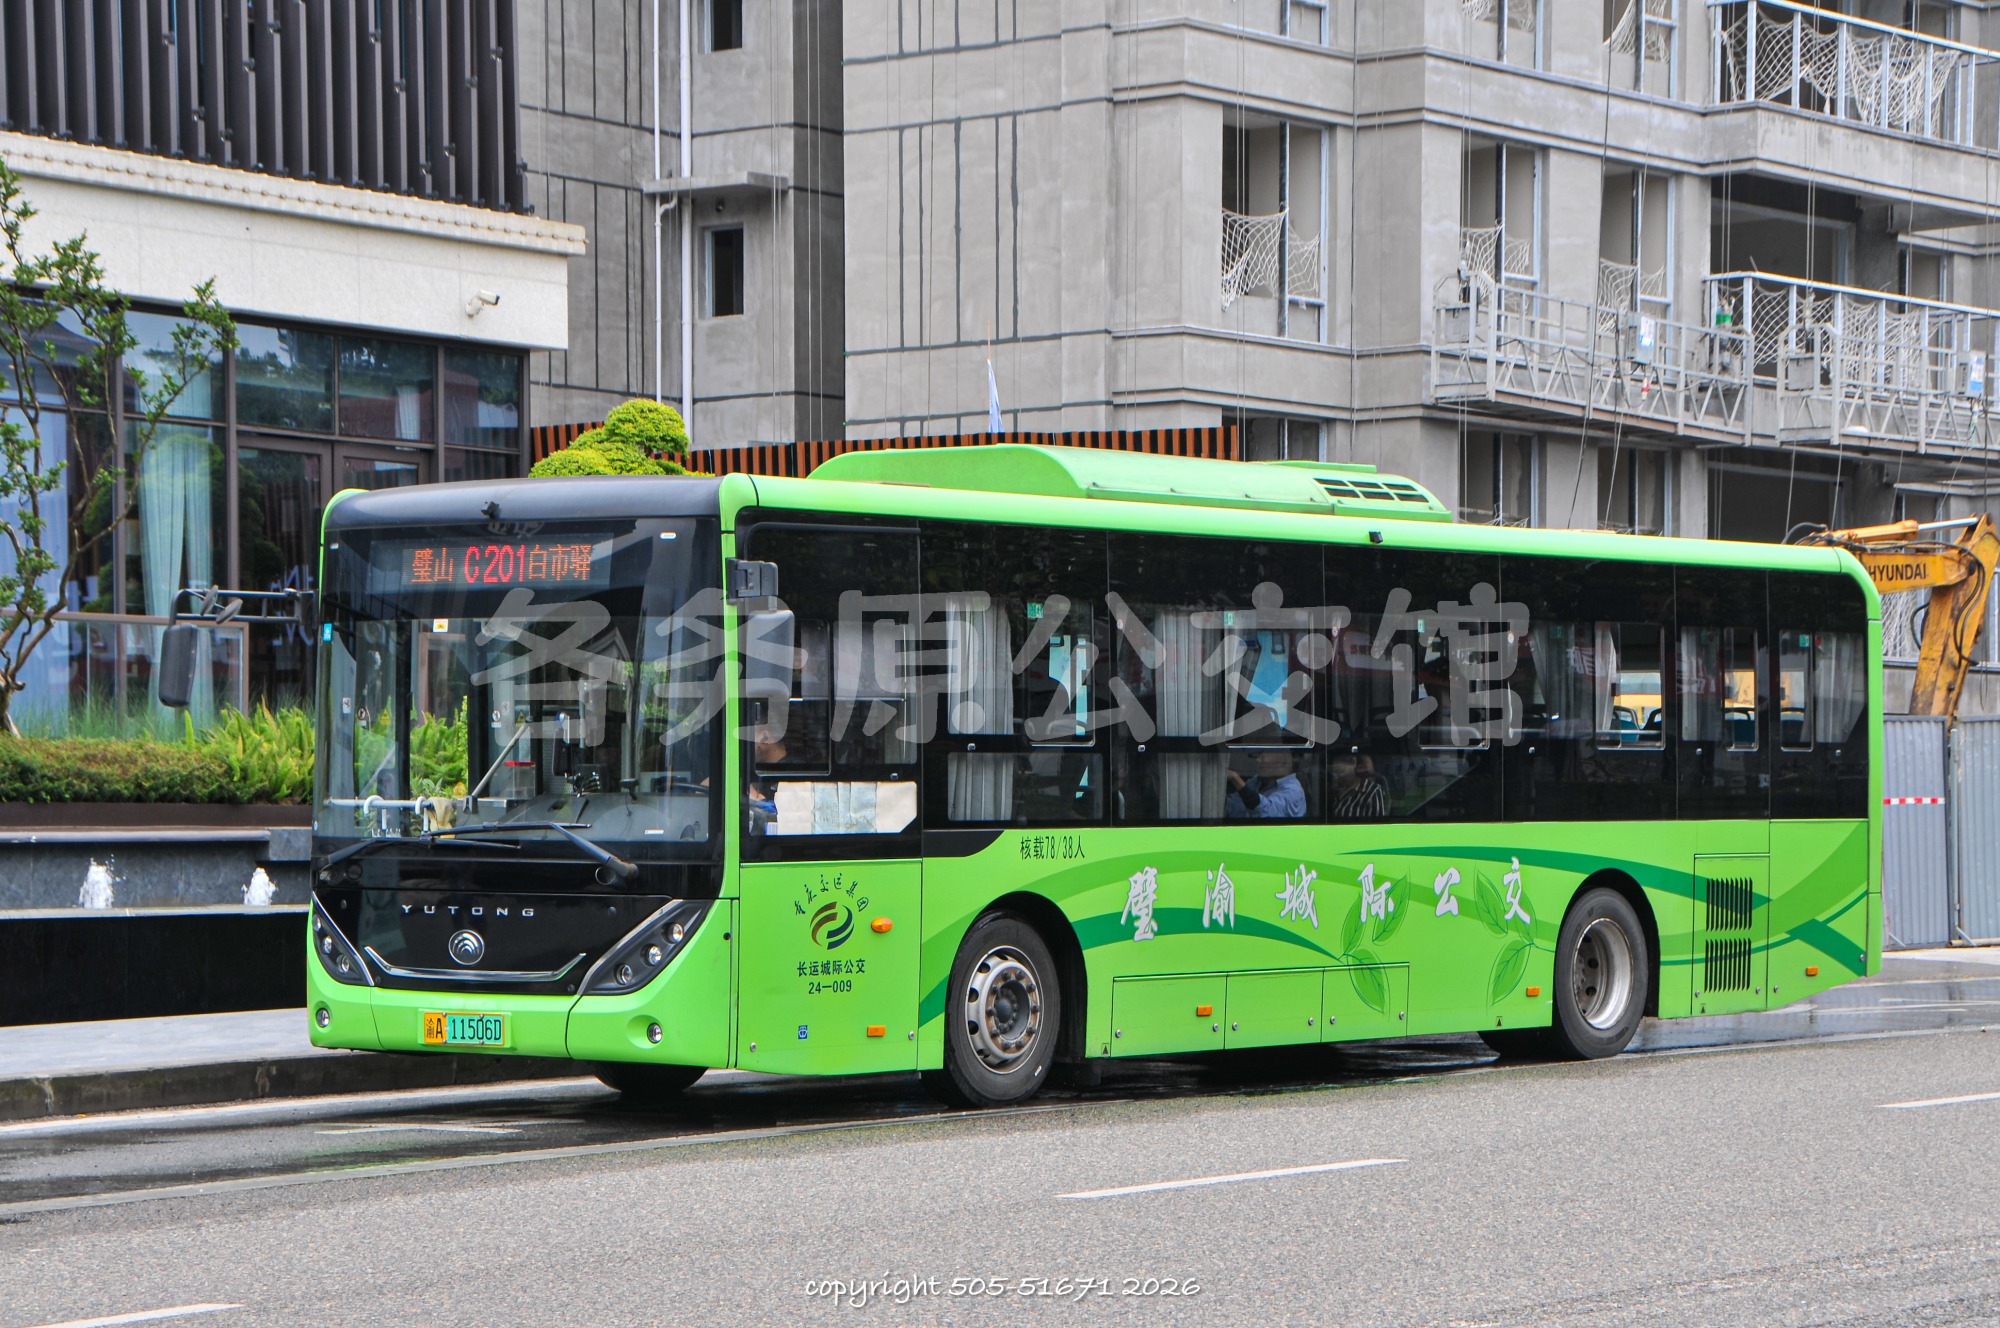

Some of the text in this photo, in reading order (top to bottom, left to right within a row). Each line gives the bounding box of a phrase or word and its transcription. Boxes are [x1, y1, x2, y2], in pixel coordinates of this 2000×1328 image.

[464, 544, 526, 583] C201
[1868, 562, 1927, 582] HYUNDAI
[1019, 835, 1086, 861] 核载78/38人
[401, 904, 535, 918] YUTONG
[797, 958, 866, 977] 长运城际公交
